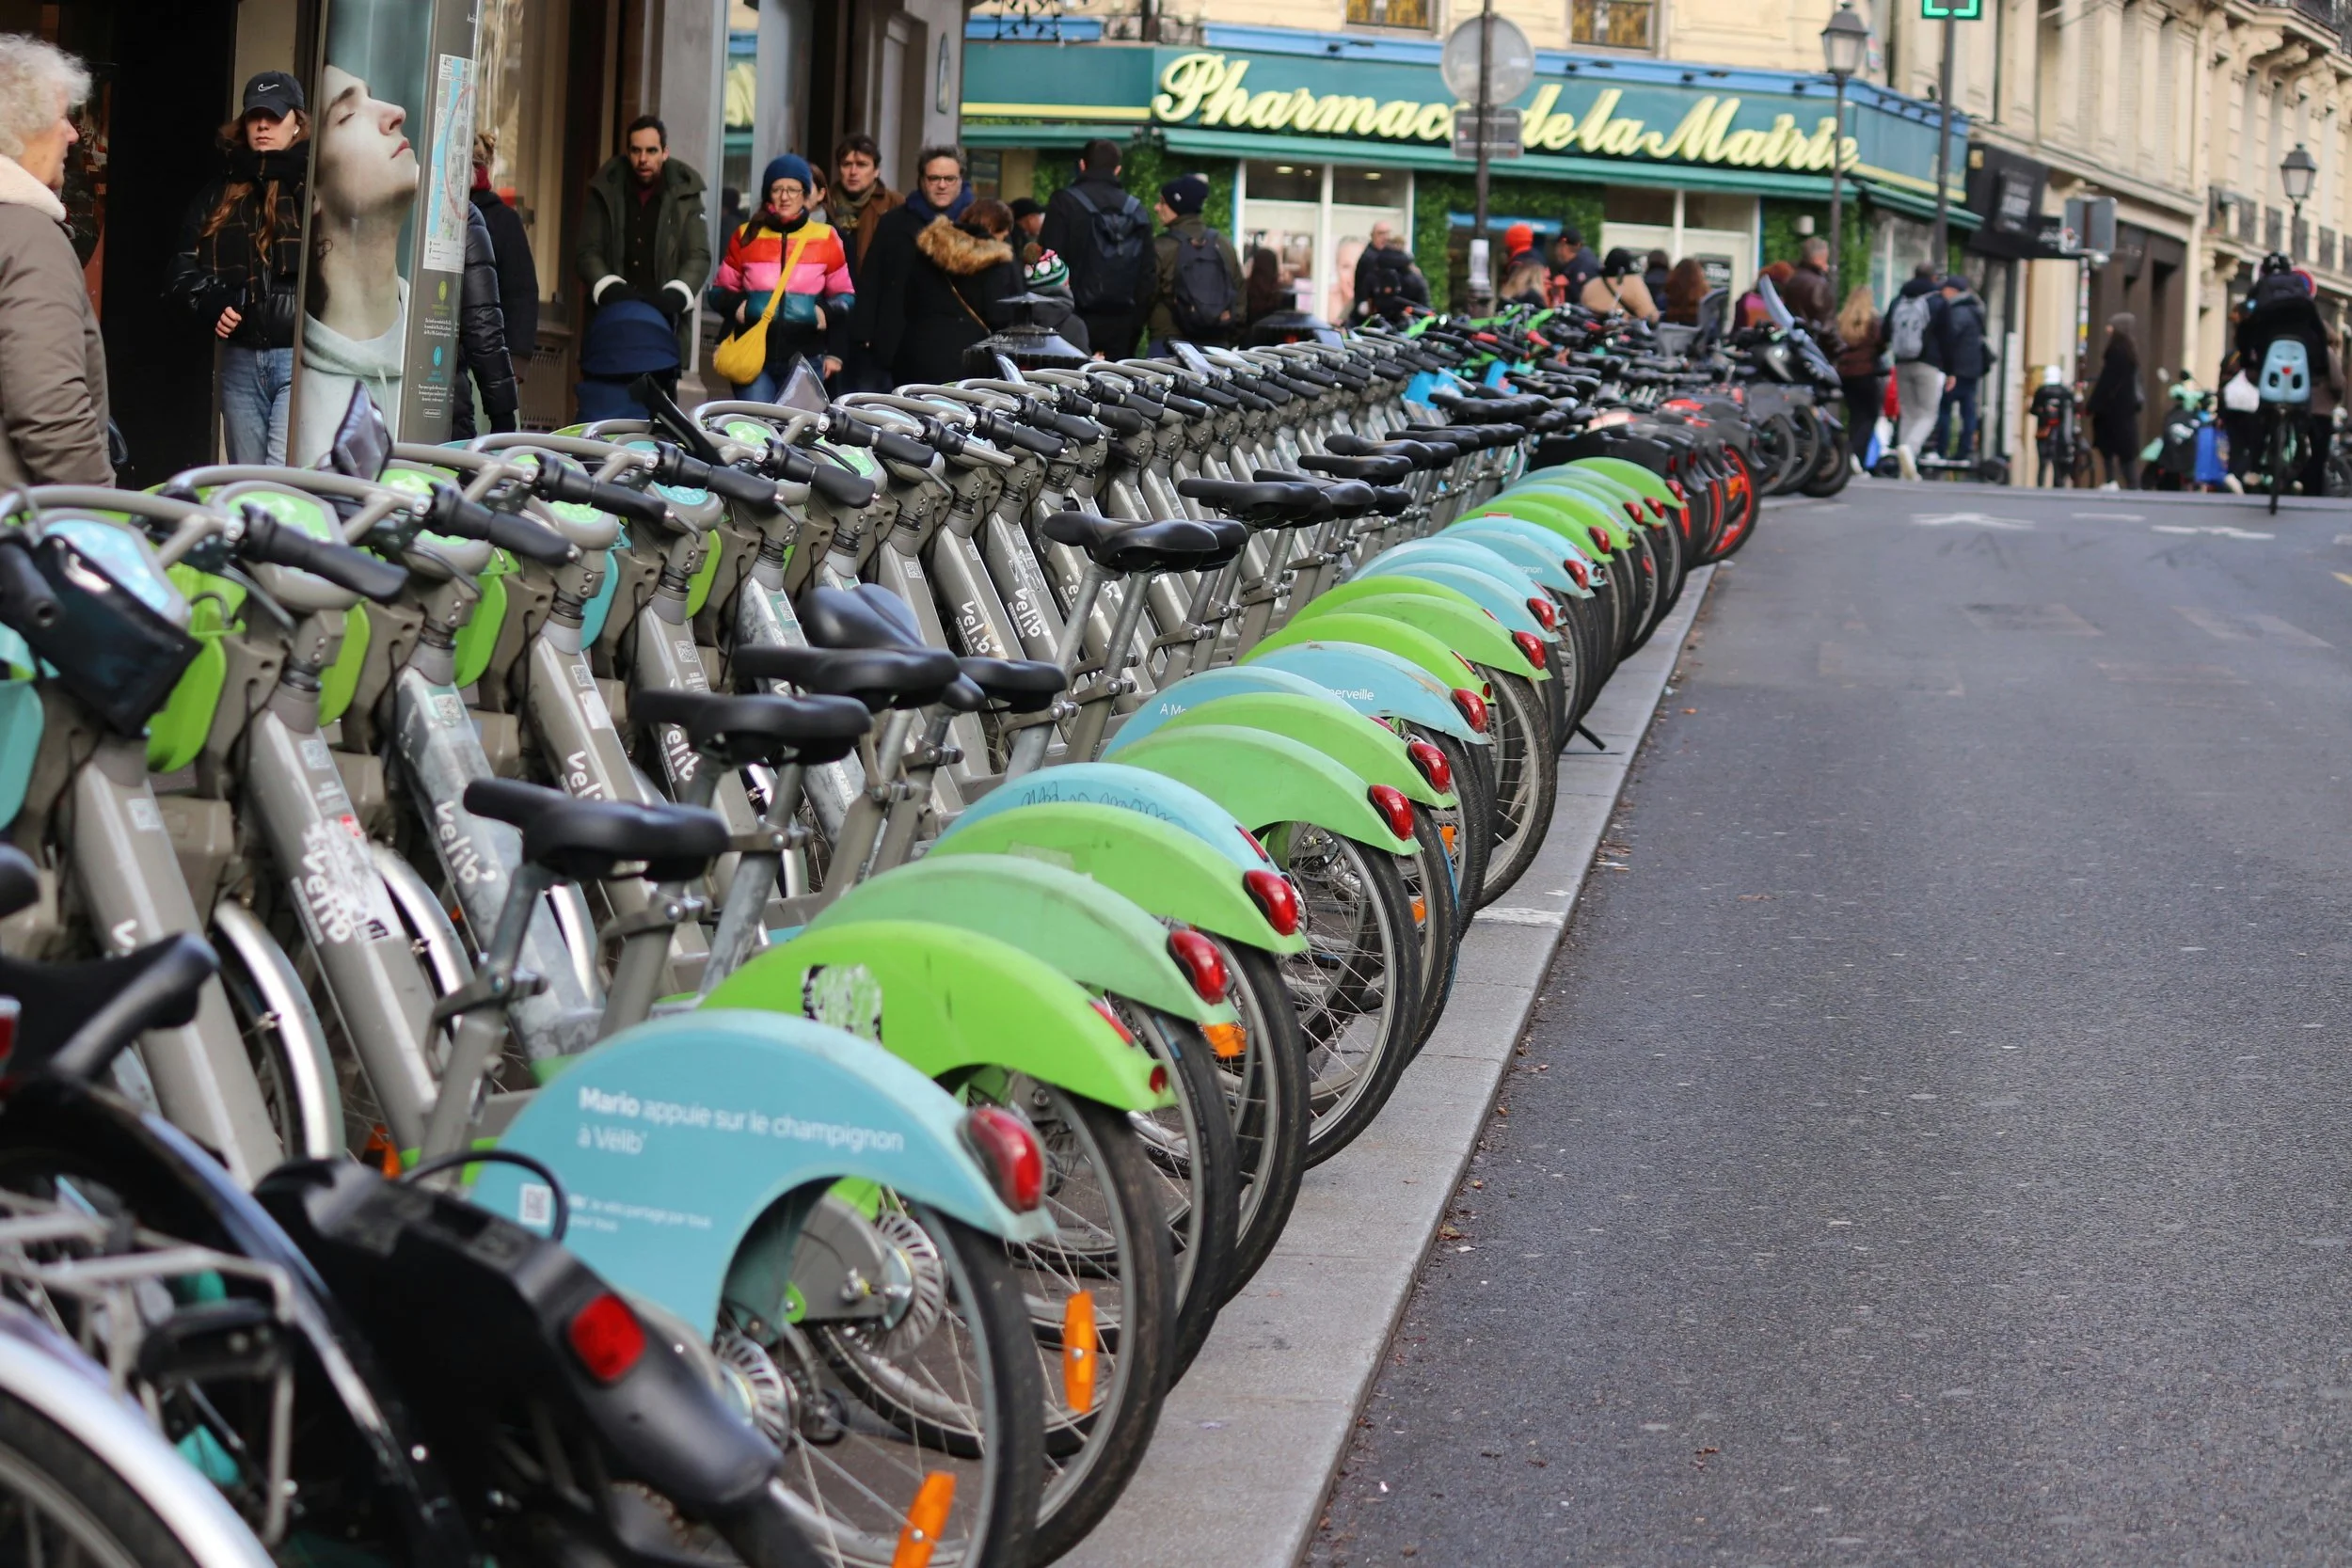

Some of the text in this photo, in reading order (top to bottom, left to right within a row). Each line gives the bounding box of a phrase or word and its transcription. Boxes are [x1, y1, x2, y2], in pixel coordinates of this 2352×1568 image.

[1576, 88, 1645, 156] la
[1645, 95, 1859, 173] Mairie
[579, 1085, 905, 1153] Mario appuie sur le champignon
